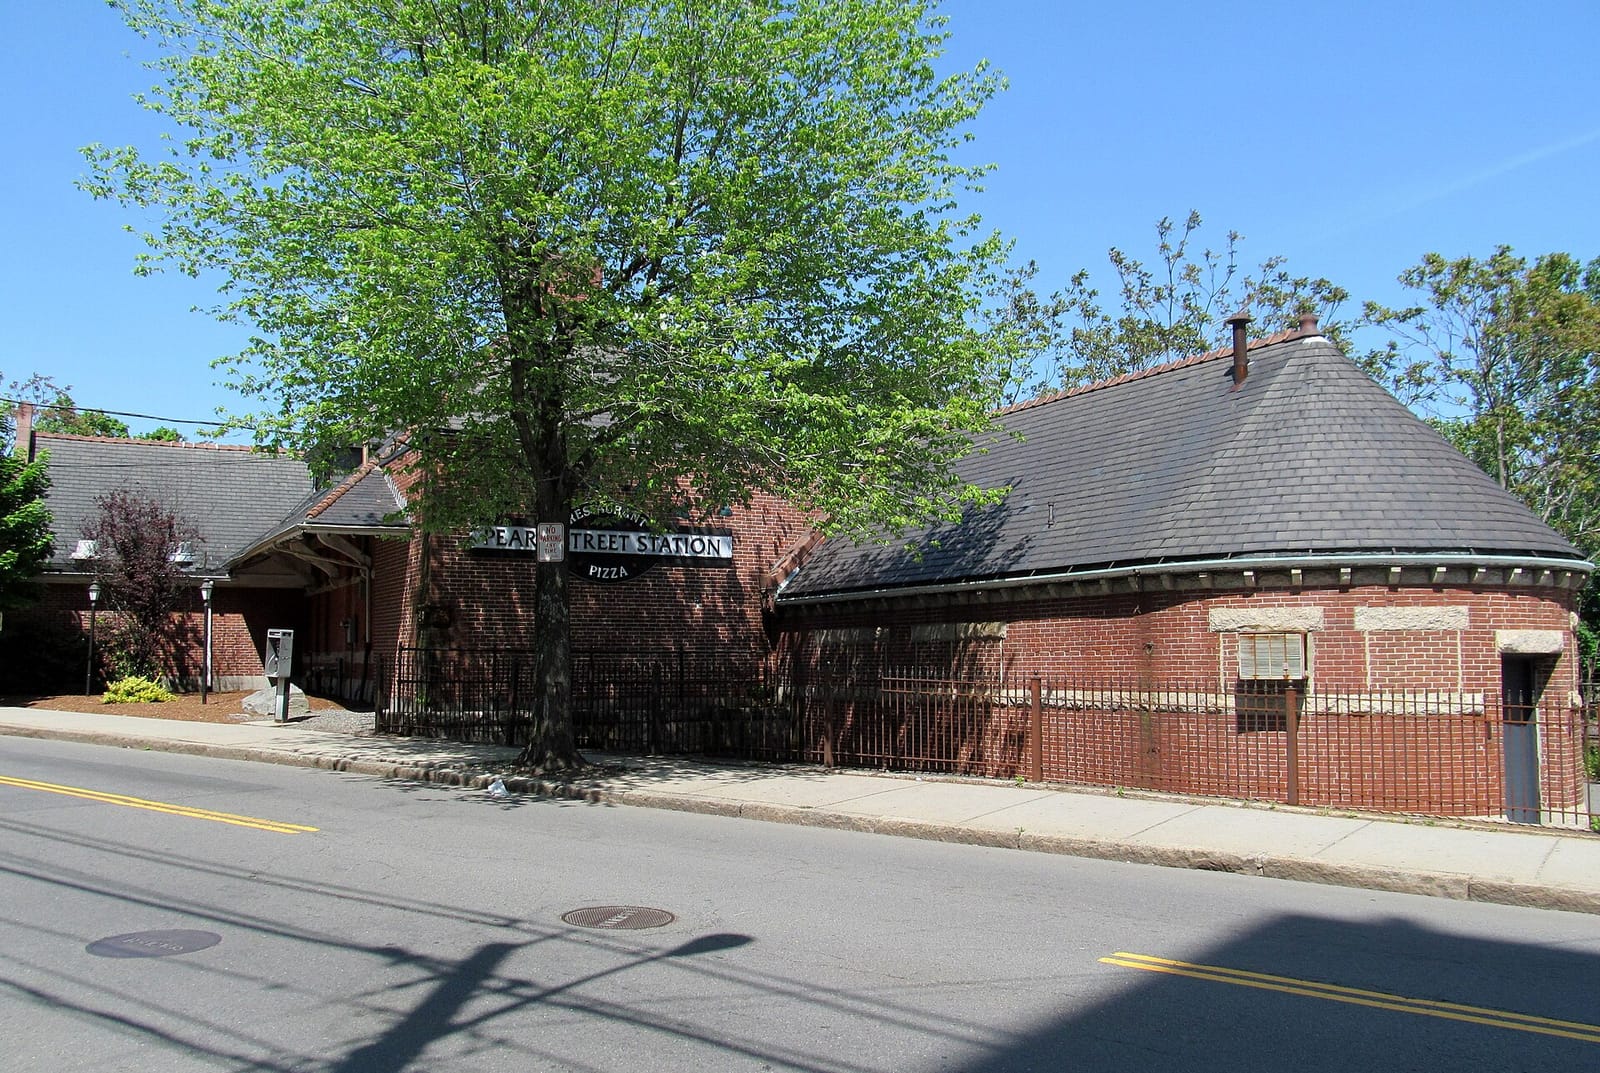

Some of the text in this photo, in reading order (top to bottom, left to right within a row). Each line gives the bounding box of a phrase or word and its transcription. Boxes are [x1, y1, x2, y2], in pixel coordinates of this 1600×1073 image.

[569, 504, 648, 527] RESAURANT
[546, 526, 556, 534] NO
[484, 528, 721, 555] PEAR TREET STATION
[588, 564, 629, 579] PIZZA
